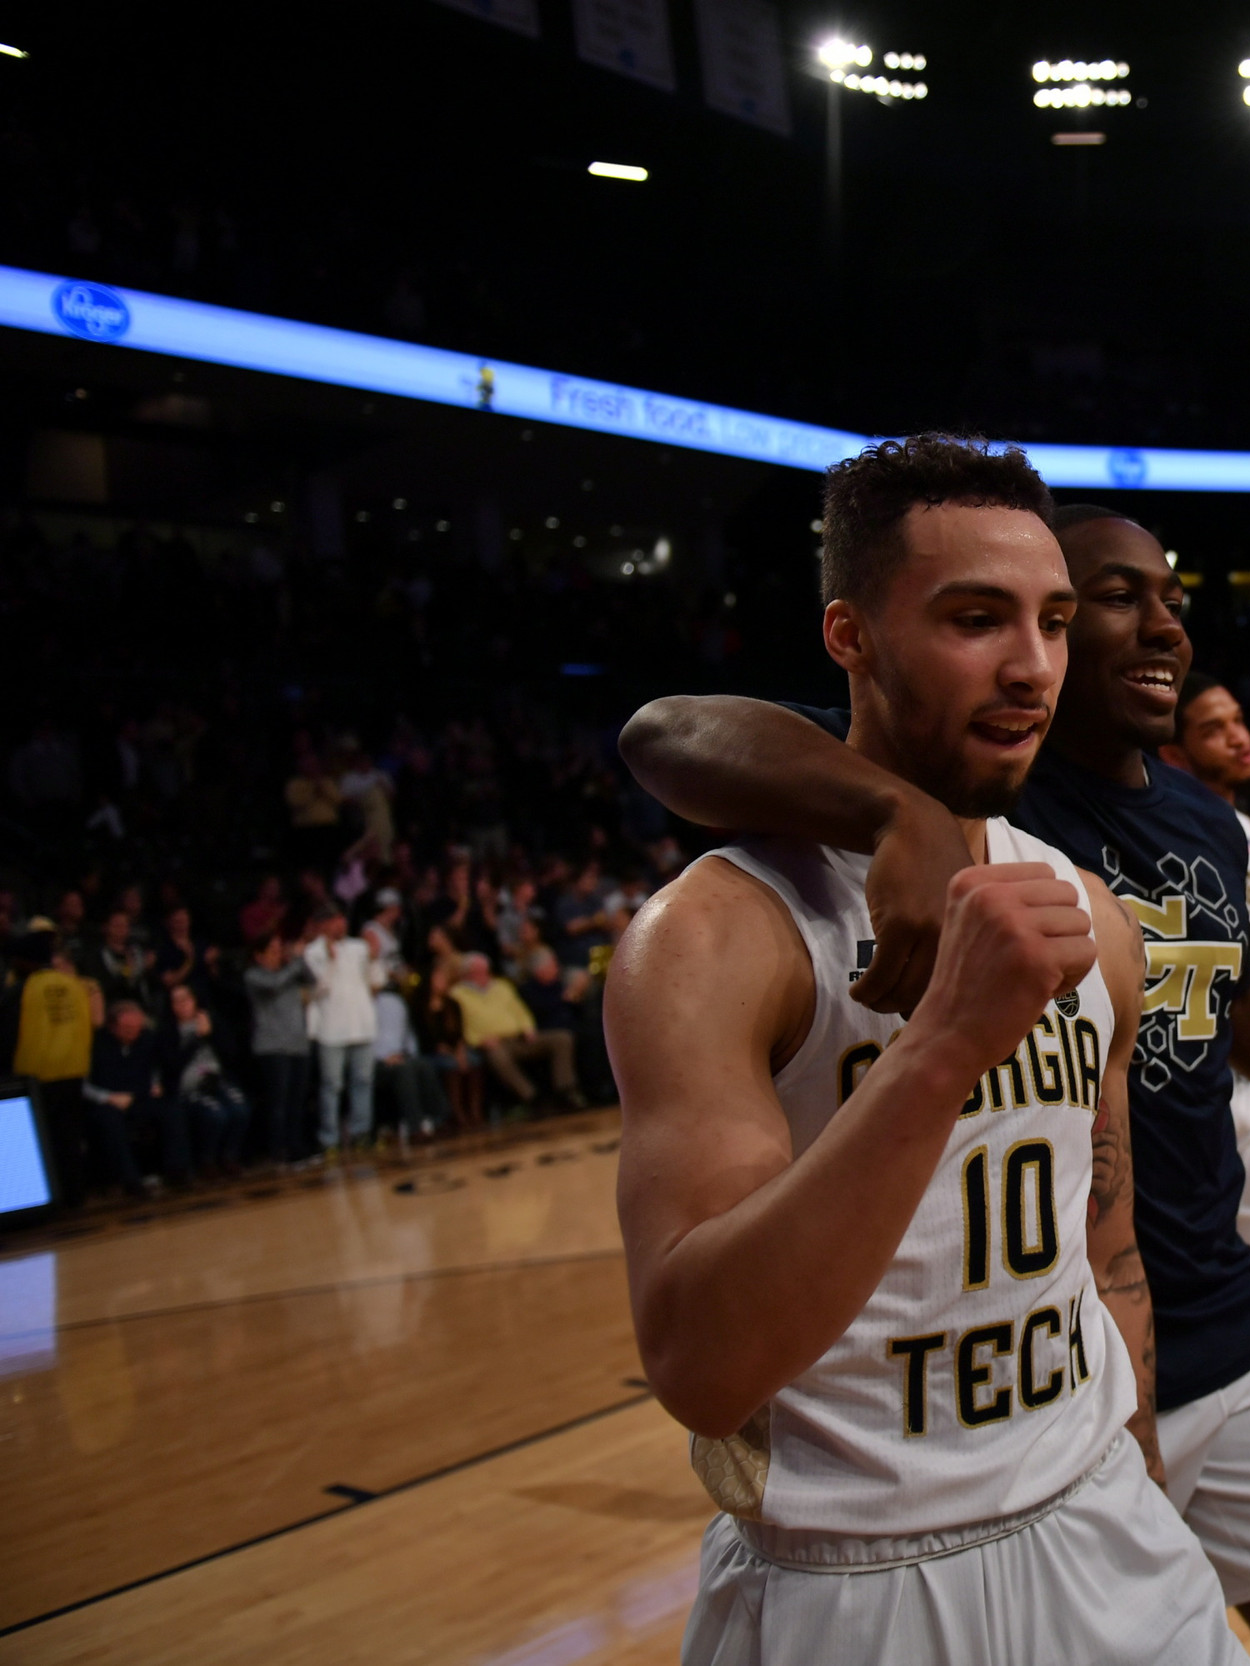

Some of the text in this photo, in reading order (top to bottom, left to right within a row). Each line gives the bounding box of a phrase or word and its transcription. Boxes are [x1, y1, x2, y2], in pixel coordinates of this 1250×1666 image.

[61, 284, 124, 337] Kroger
[961, 1137, 1060, 1292] 10
[887, 1285, 1092, 1439] TECH
